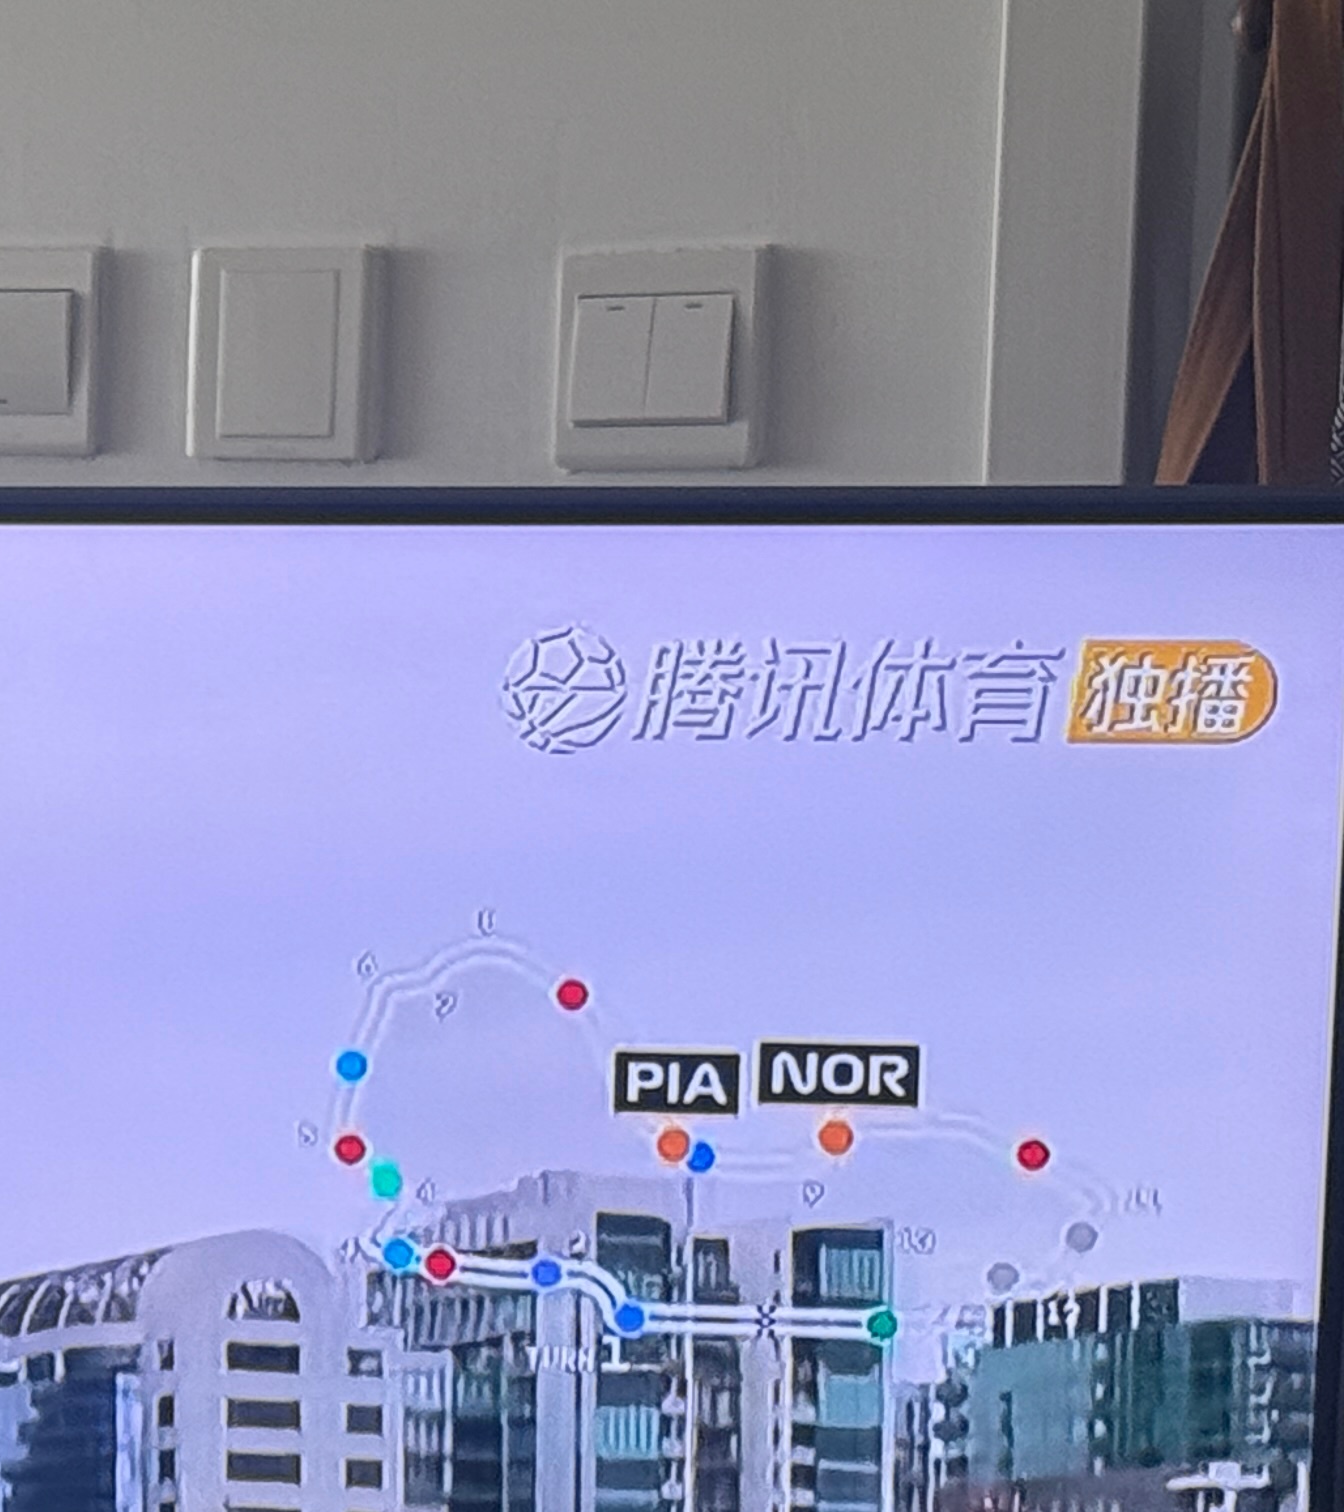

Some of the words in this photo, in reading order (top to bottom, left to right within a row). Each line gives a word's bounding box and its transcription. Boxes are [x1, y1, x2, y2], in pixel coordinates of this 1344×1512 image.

[632, 639, 1066, 744] 腾讯体育
[1080, 648, 1256, 736] 独播
[625, 1062, 727, 1107] PIA
[770, 1051, 910, 1099] NOR
